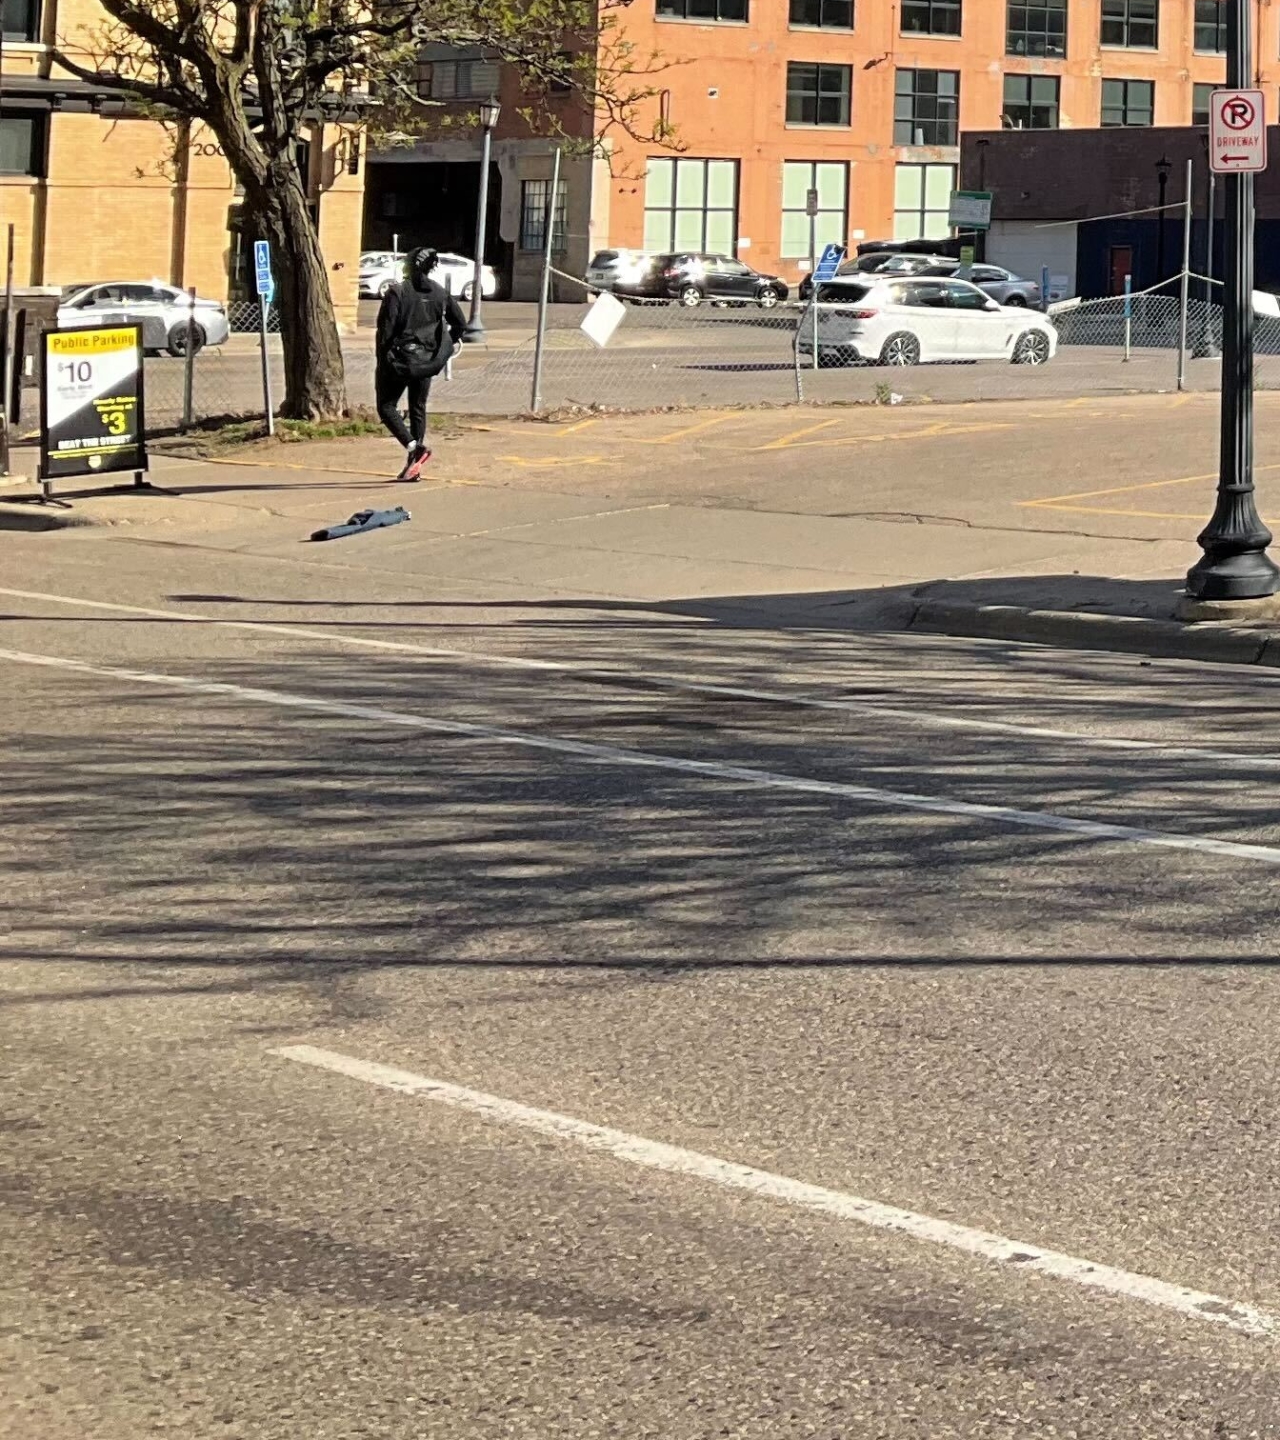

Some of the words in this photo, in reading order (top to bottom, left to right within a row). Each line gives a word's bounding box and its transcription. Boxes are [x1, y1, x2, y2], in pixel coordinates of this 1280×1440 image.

[1217, 136, 1259, 148] DRIVEWAY
[53, 338, 89, 349] Public
[92, 334, 135, 347] Parking
[57, 361, 92, 382] $10
[101, 411, 126, 435] $3
